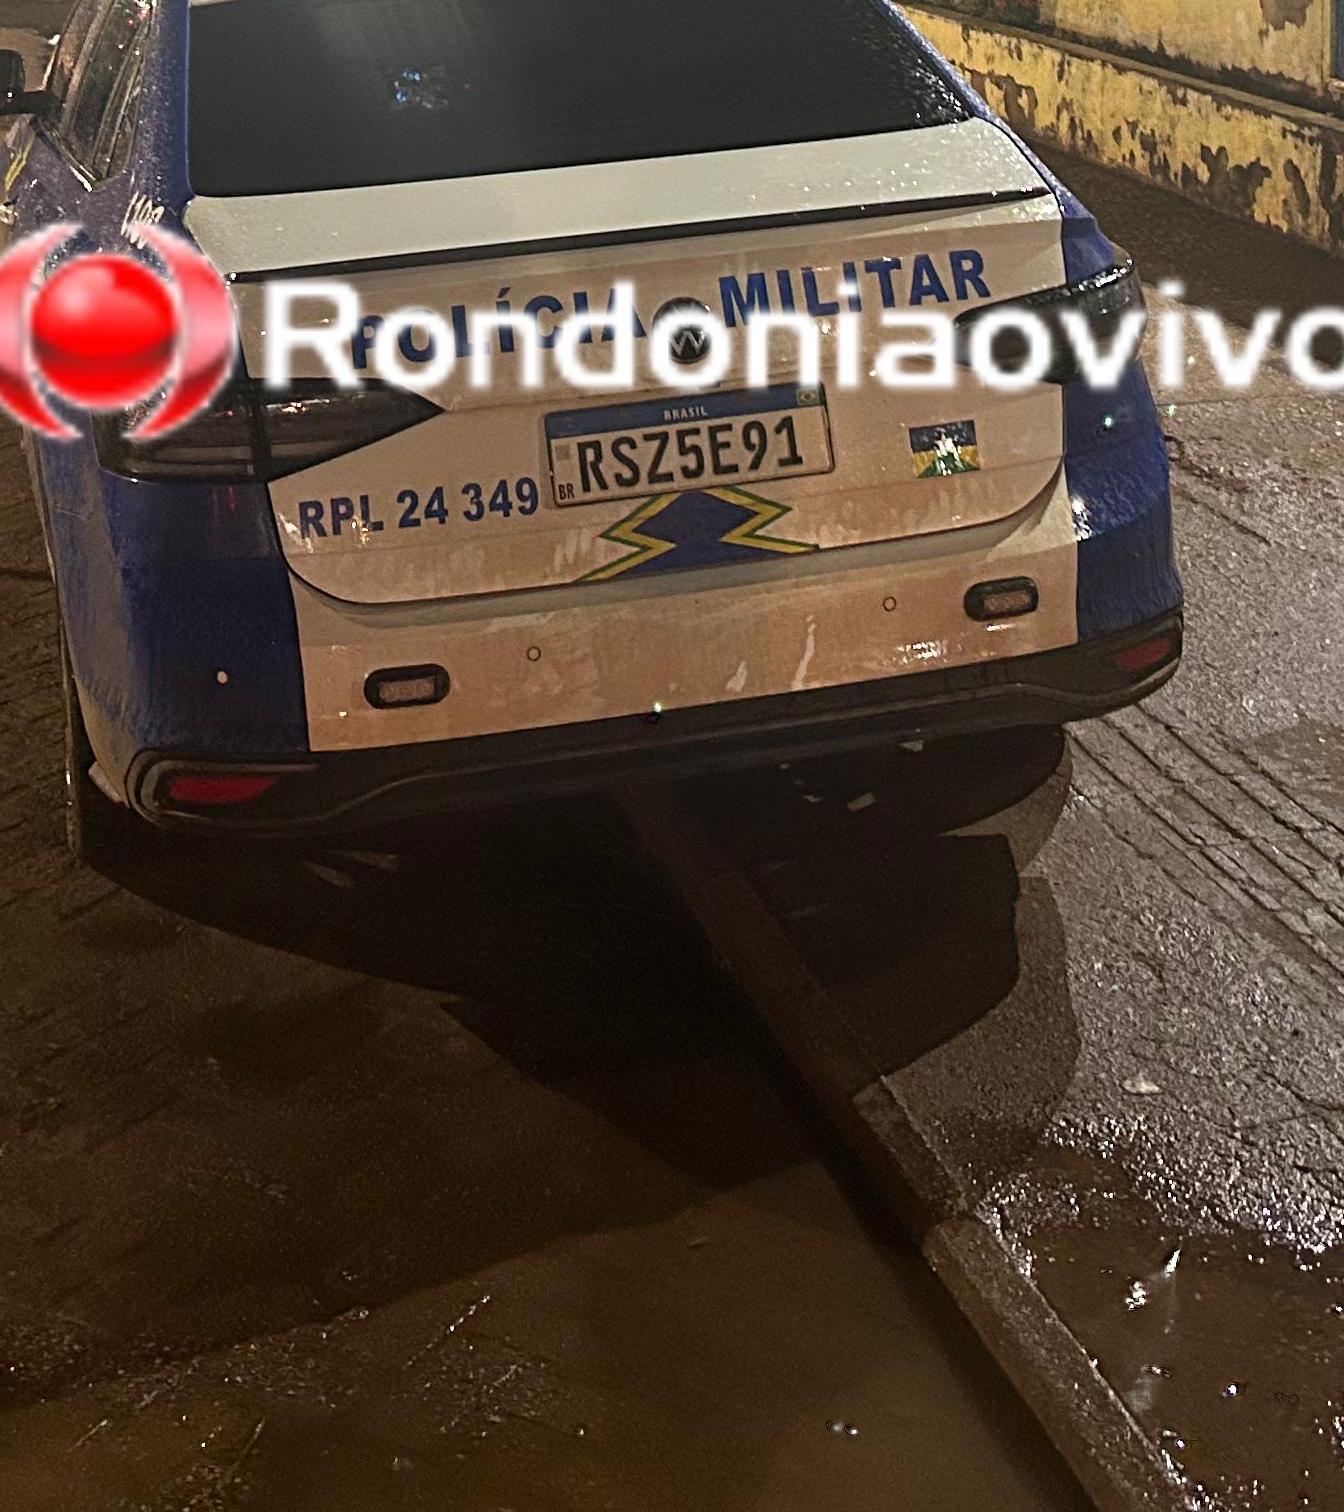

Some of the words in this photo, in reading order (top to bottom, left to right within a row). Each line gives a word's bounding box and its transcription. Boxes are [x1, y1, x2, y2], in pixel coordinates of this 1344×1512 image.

[718, 249, 992, 327] MILITAR
[663, 405, 709, 421] BRASIL
[576, 415, 804, 493] RSZ5E91
[298, 494, 384, 539] RPL
[396, 486, 449, 529] 24
[462, 477, 539, 522] 349
[558, 482, 575, 500] BR
